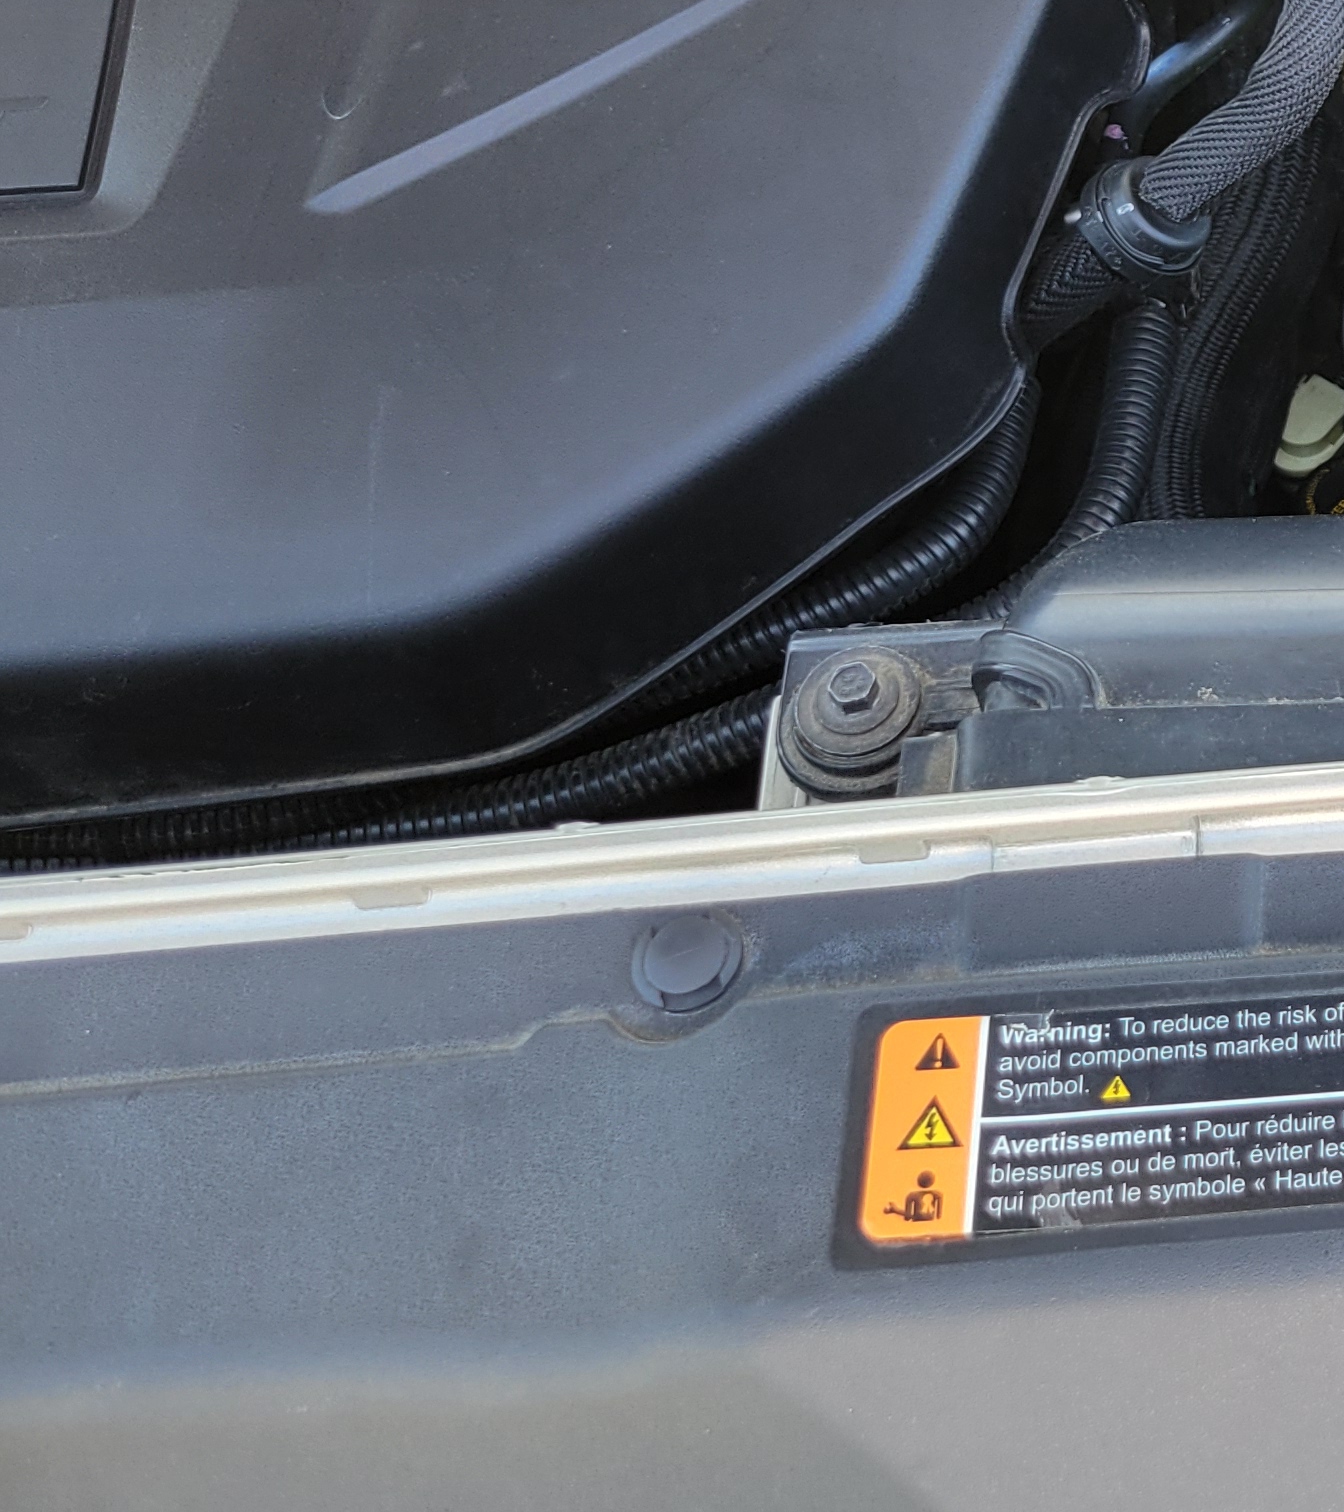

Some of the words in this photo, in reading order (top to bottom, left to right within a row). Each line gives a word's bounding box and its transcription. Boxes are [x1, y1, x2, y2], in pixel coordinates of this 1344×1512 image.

[1120, 1017, 1145, 1037] To
[1152, 1012, 1230, 1034] reduce
[1237, 1008, 1271, 1028] the
[1278, 1006, 1317, 1025] risk
[999, 1049, 1062, 1072] avoid
[1069, 1039, 1208, 1069] components
[1215, 1033, 1298, 1057] marked
[997, 1075, 1090, 1102] Symbol.
[992, 1124, 1172, 1156] Avertissement
[1195, 1119, 1249, 1141] Pour
[1256, 1113, 1336, 1136] réduire
[991, 1158, 1103, 1184] blessures
[1111, 1157, 1140, 1175] ou
[1148, 1151, 1176, 1172] de
[1184, 1147, 1241, 1170] mort,
[1250, 1141, 1312, 1163] éviter
[988, 1190, 1024, 1216] qui
[1032, 1185, 1113, 1215] portent
[1122, 1182, 1142, 1204] le
[1149, 1174, 1246, 1205] symbole
[1275, 1168, 1343, 1190] Haute
